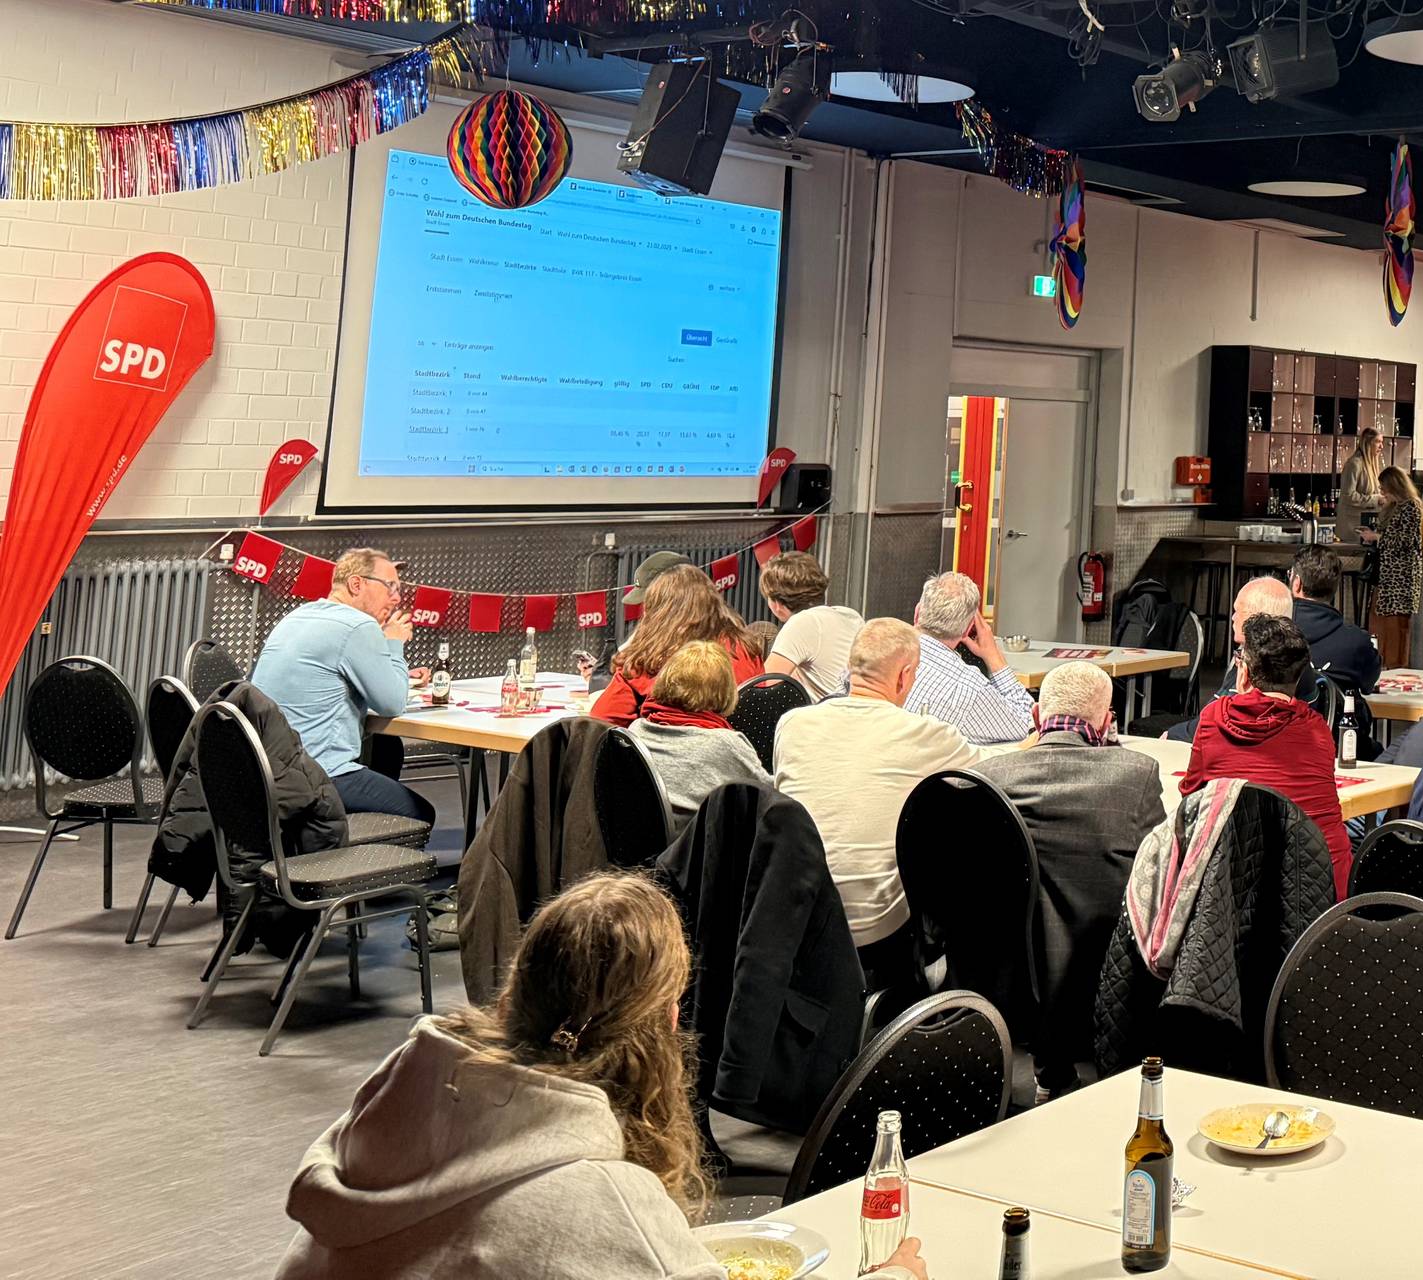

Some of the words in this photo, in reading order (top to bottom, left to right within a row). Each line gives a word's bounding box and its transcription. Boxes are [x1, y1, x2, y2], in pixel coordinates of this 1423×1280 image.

[426, 209, 444, 218] Wahl
[446, 213, 460, 221] zum
[462, 214, 496, 225] Deutschen
[499, 219, 532, 231] Bundestag
[100, 338, 166, 380] SPD
[414, 369, 450, 378] Stadtbezirk
[464, 372, 481, 380] Stand
[279, 453, 303, 465] SPD
[770, 459, 786, 468] SPD
[86, 454, 128, 517] www.spd.de
[235, 556, 267, 578] SPD
[715, 573, 736, 590] SPD
[412, 608, 440, 625] SPD
[578, 611, 603, 627] SPD
